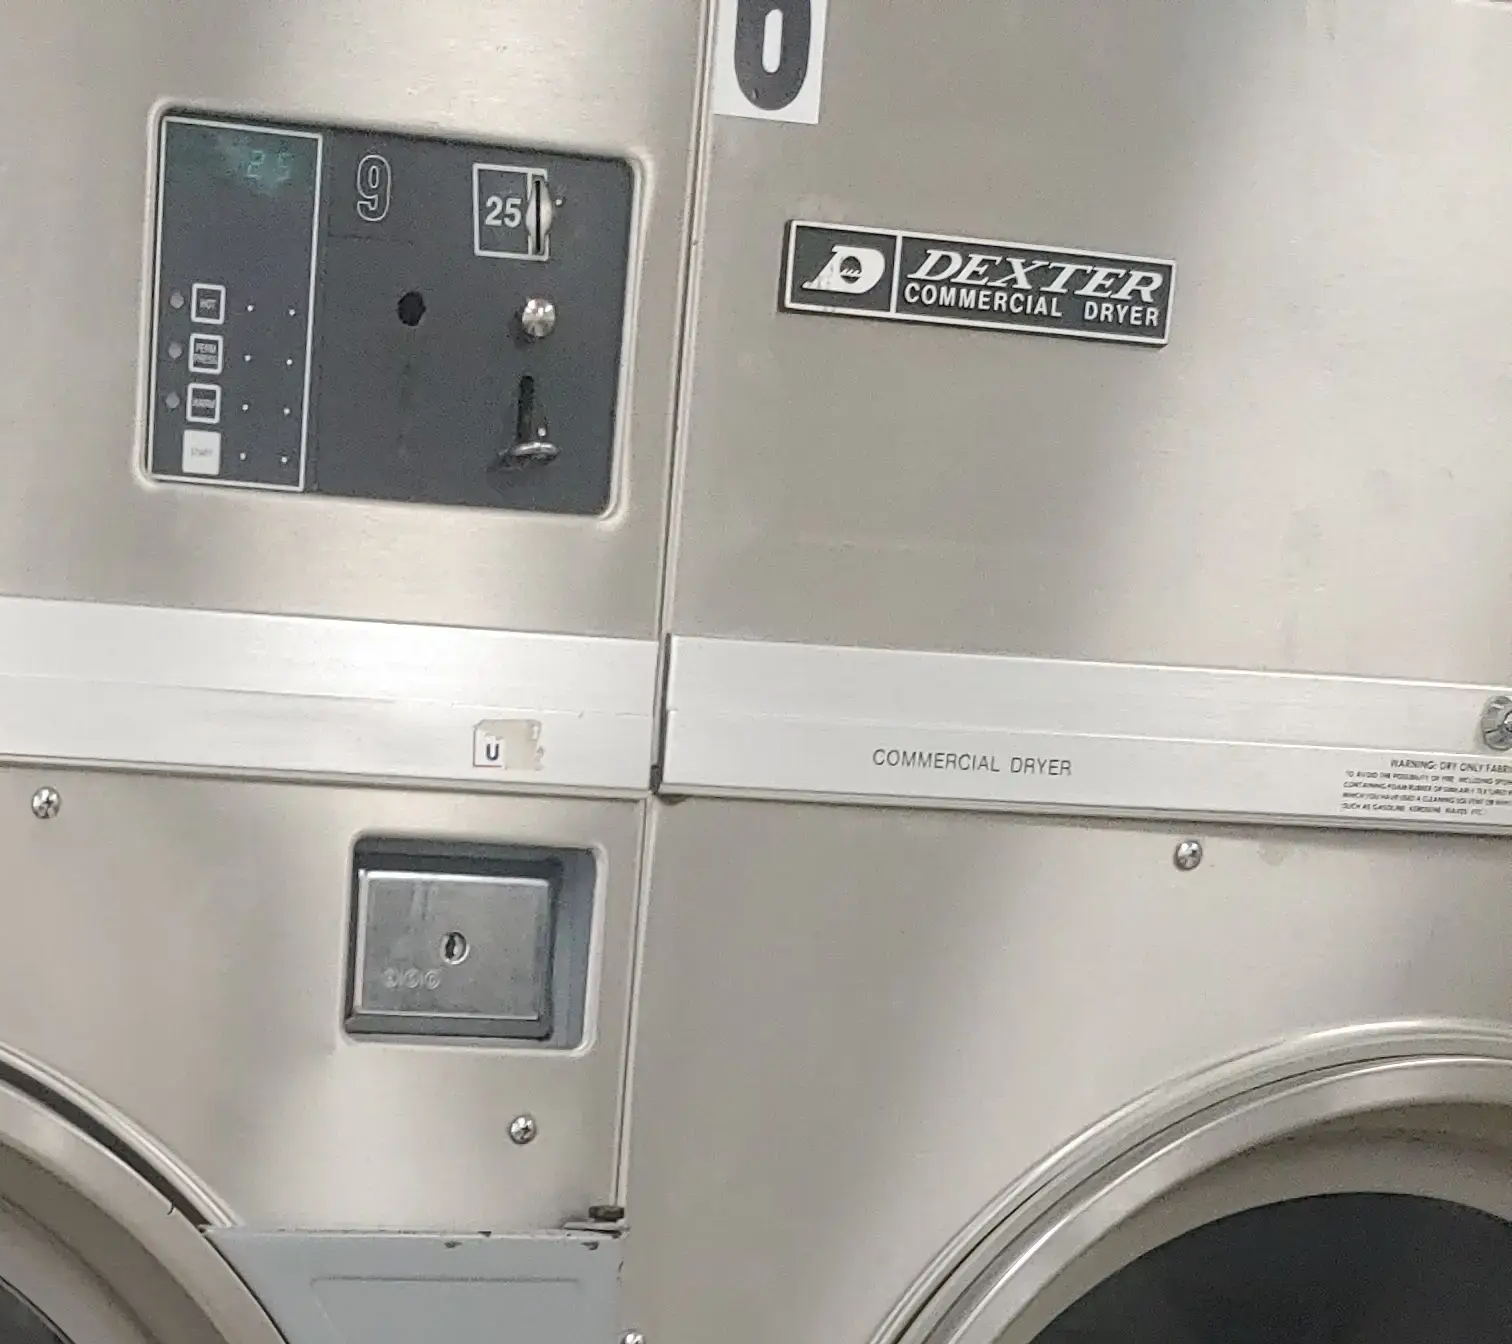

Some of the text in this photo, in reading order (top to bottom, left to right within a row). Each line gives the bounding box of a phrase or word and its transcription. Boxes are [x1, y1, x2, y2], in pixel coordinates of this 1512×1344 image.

[357, 154, 391, 221] 9
[485, 195, 522, 228] 25
[907, 249, 1163, 303] DEXTER
[904, 282, 1160, 327] COMMERCIAL DRYER
[872, 748, 1072, 776] COMMERCIAL DRYER
